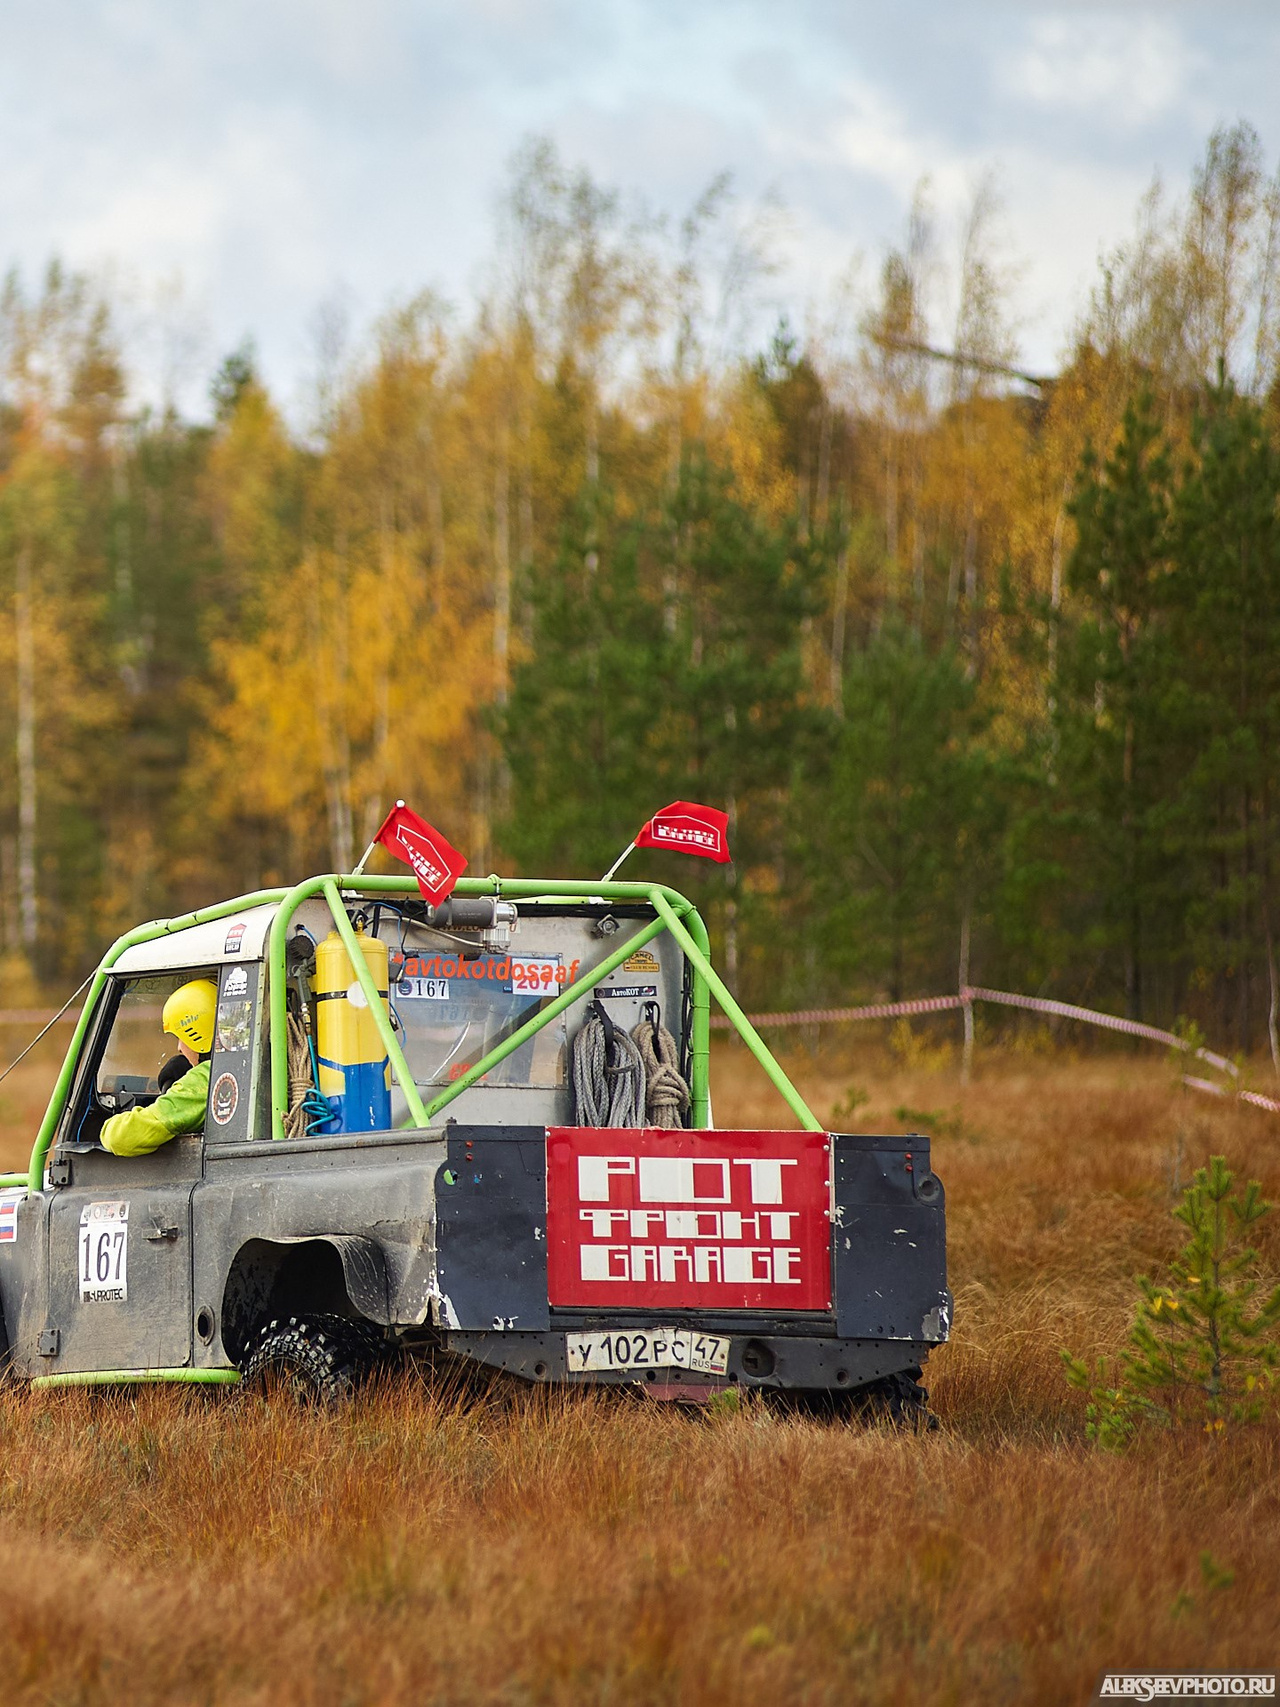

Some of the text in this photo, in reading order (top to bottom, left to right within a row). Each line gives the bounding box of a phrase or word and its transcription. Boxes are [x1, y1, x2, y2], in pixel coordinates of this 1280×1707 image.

[416, 979, 446, 997] 167
[83, 1231, 125, 1282] 167
[580, 1245, 801, 1283] GARAGE
[695, 1337, 720, 1361] 47
[692, 1358, 710, 1369] RUS
